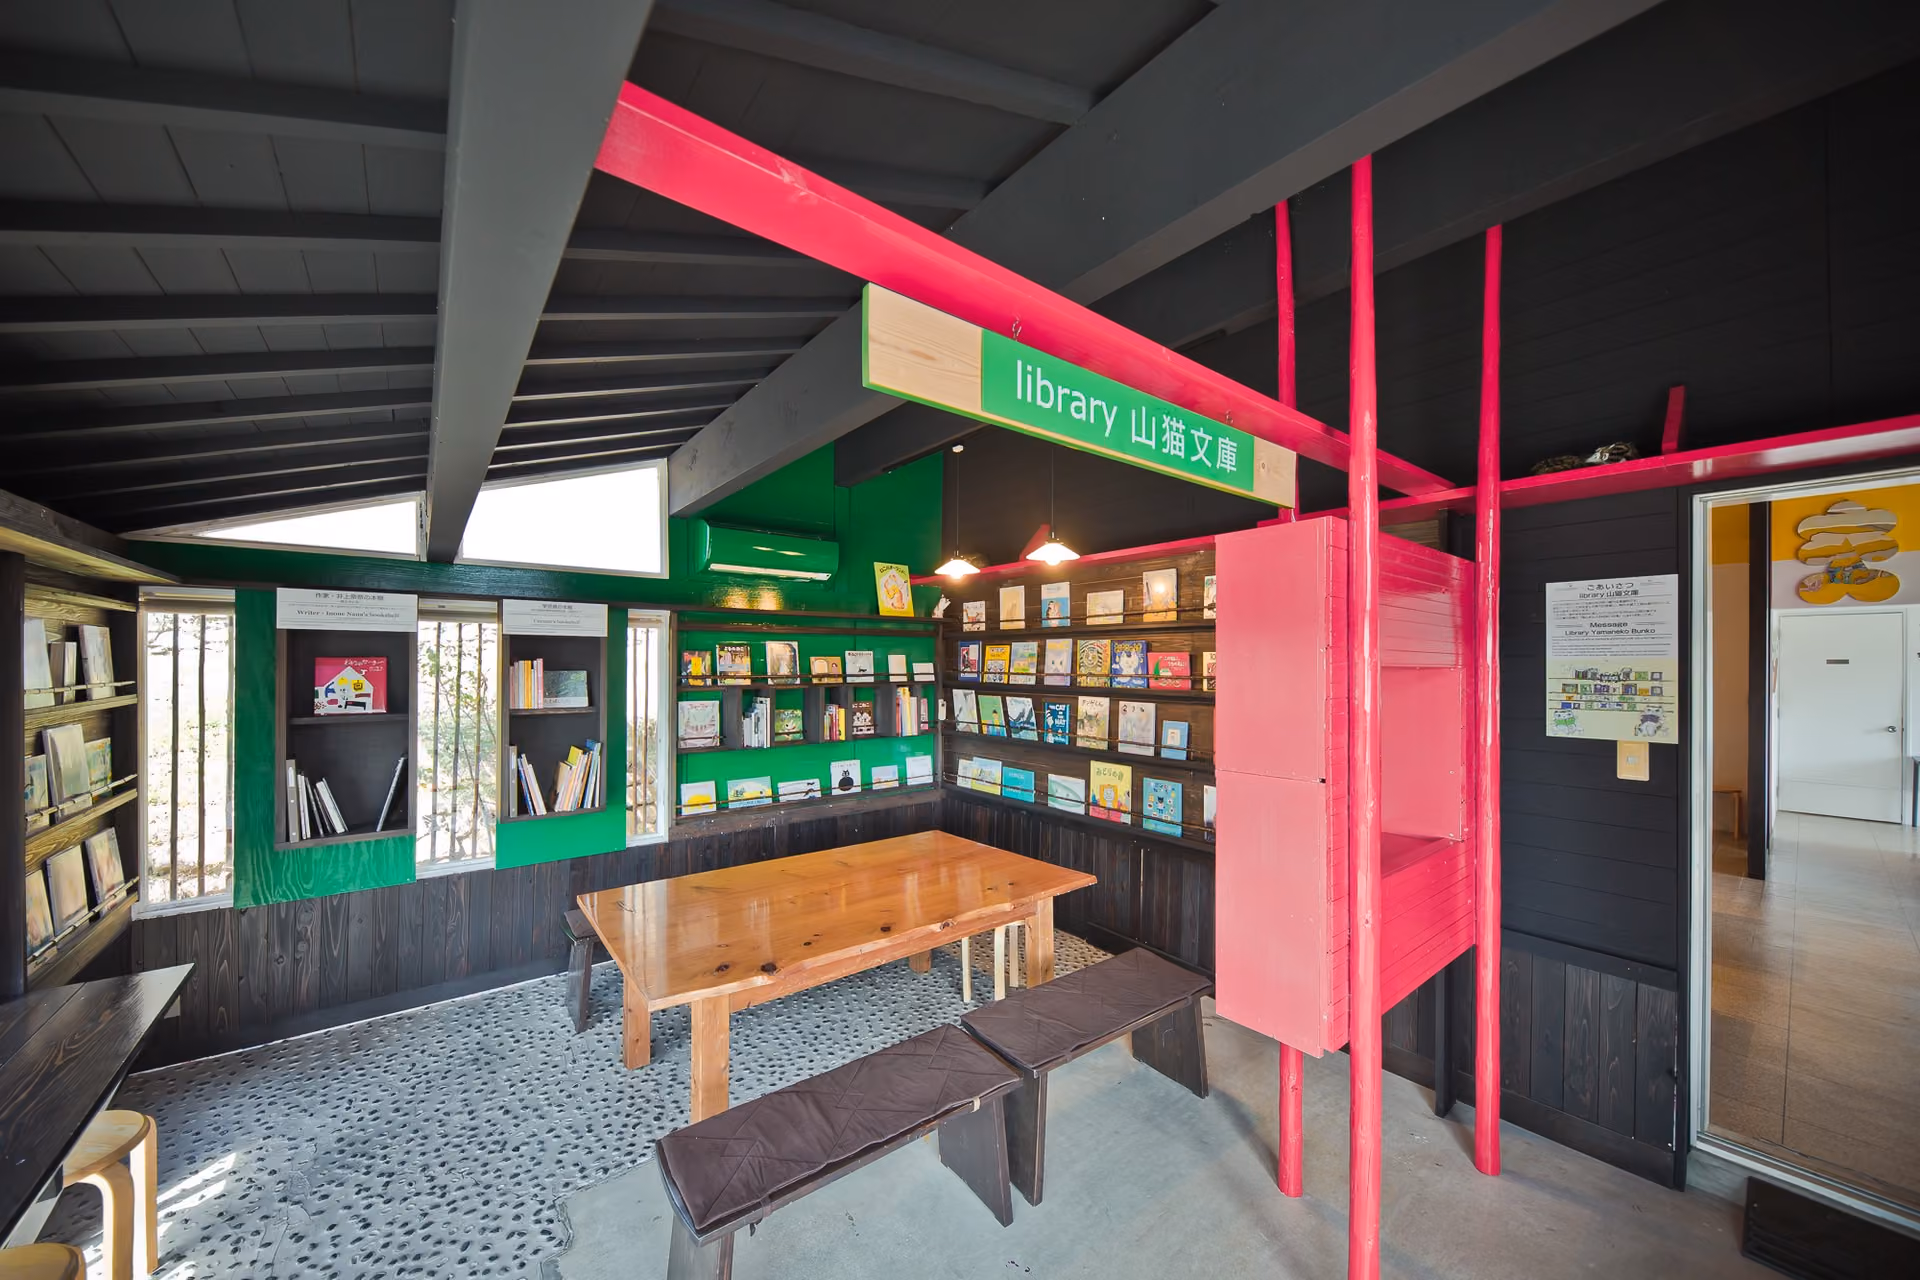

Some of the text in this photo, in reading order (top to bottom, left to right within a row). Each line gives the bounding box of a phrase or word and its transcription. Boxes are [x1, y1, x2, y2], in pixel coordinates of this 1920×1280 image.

[1016, 360, 1238, 474] library 山猫文庫
